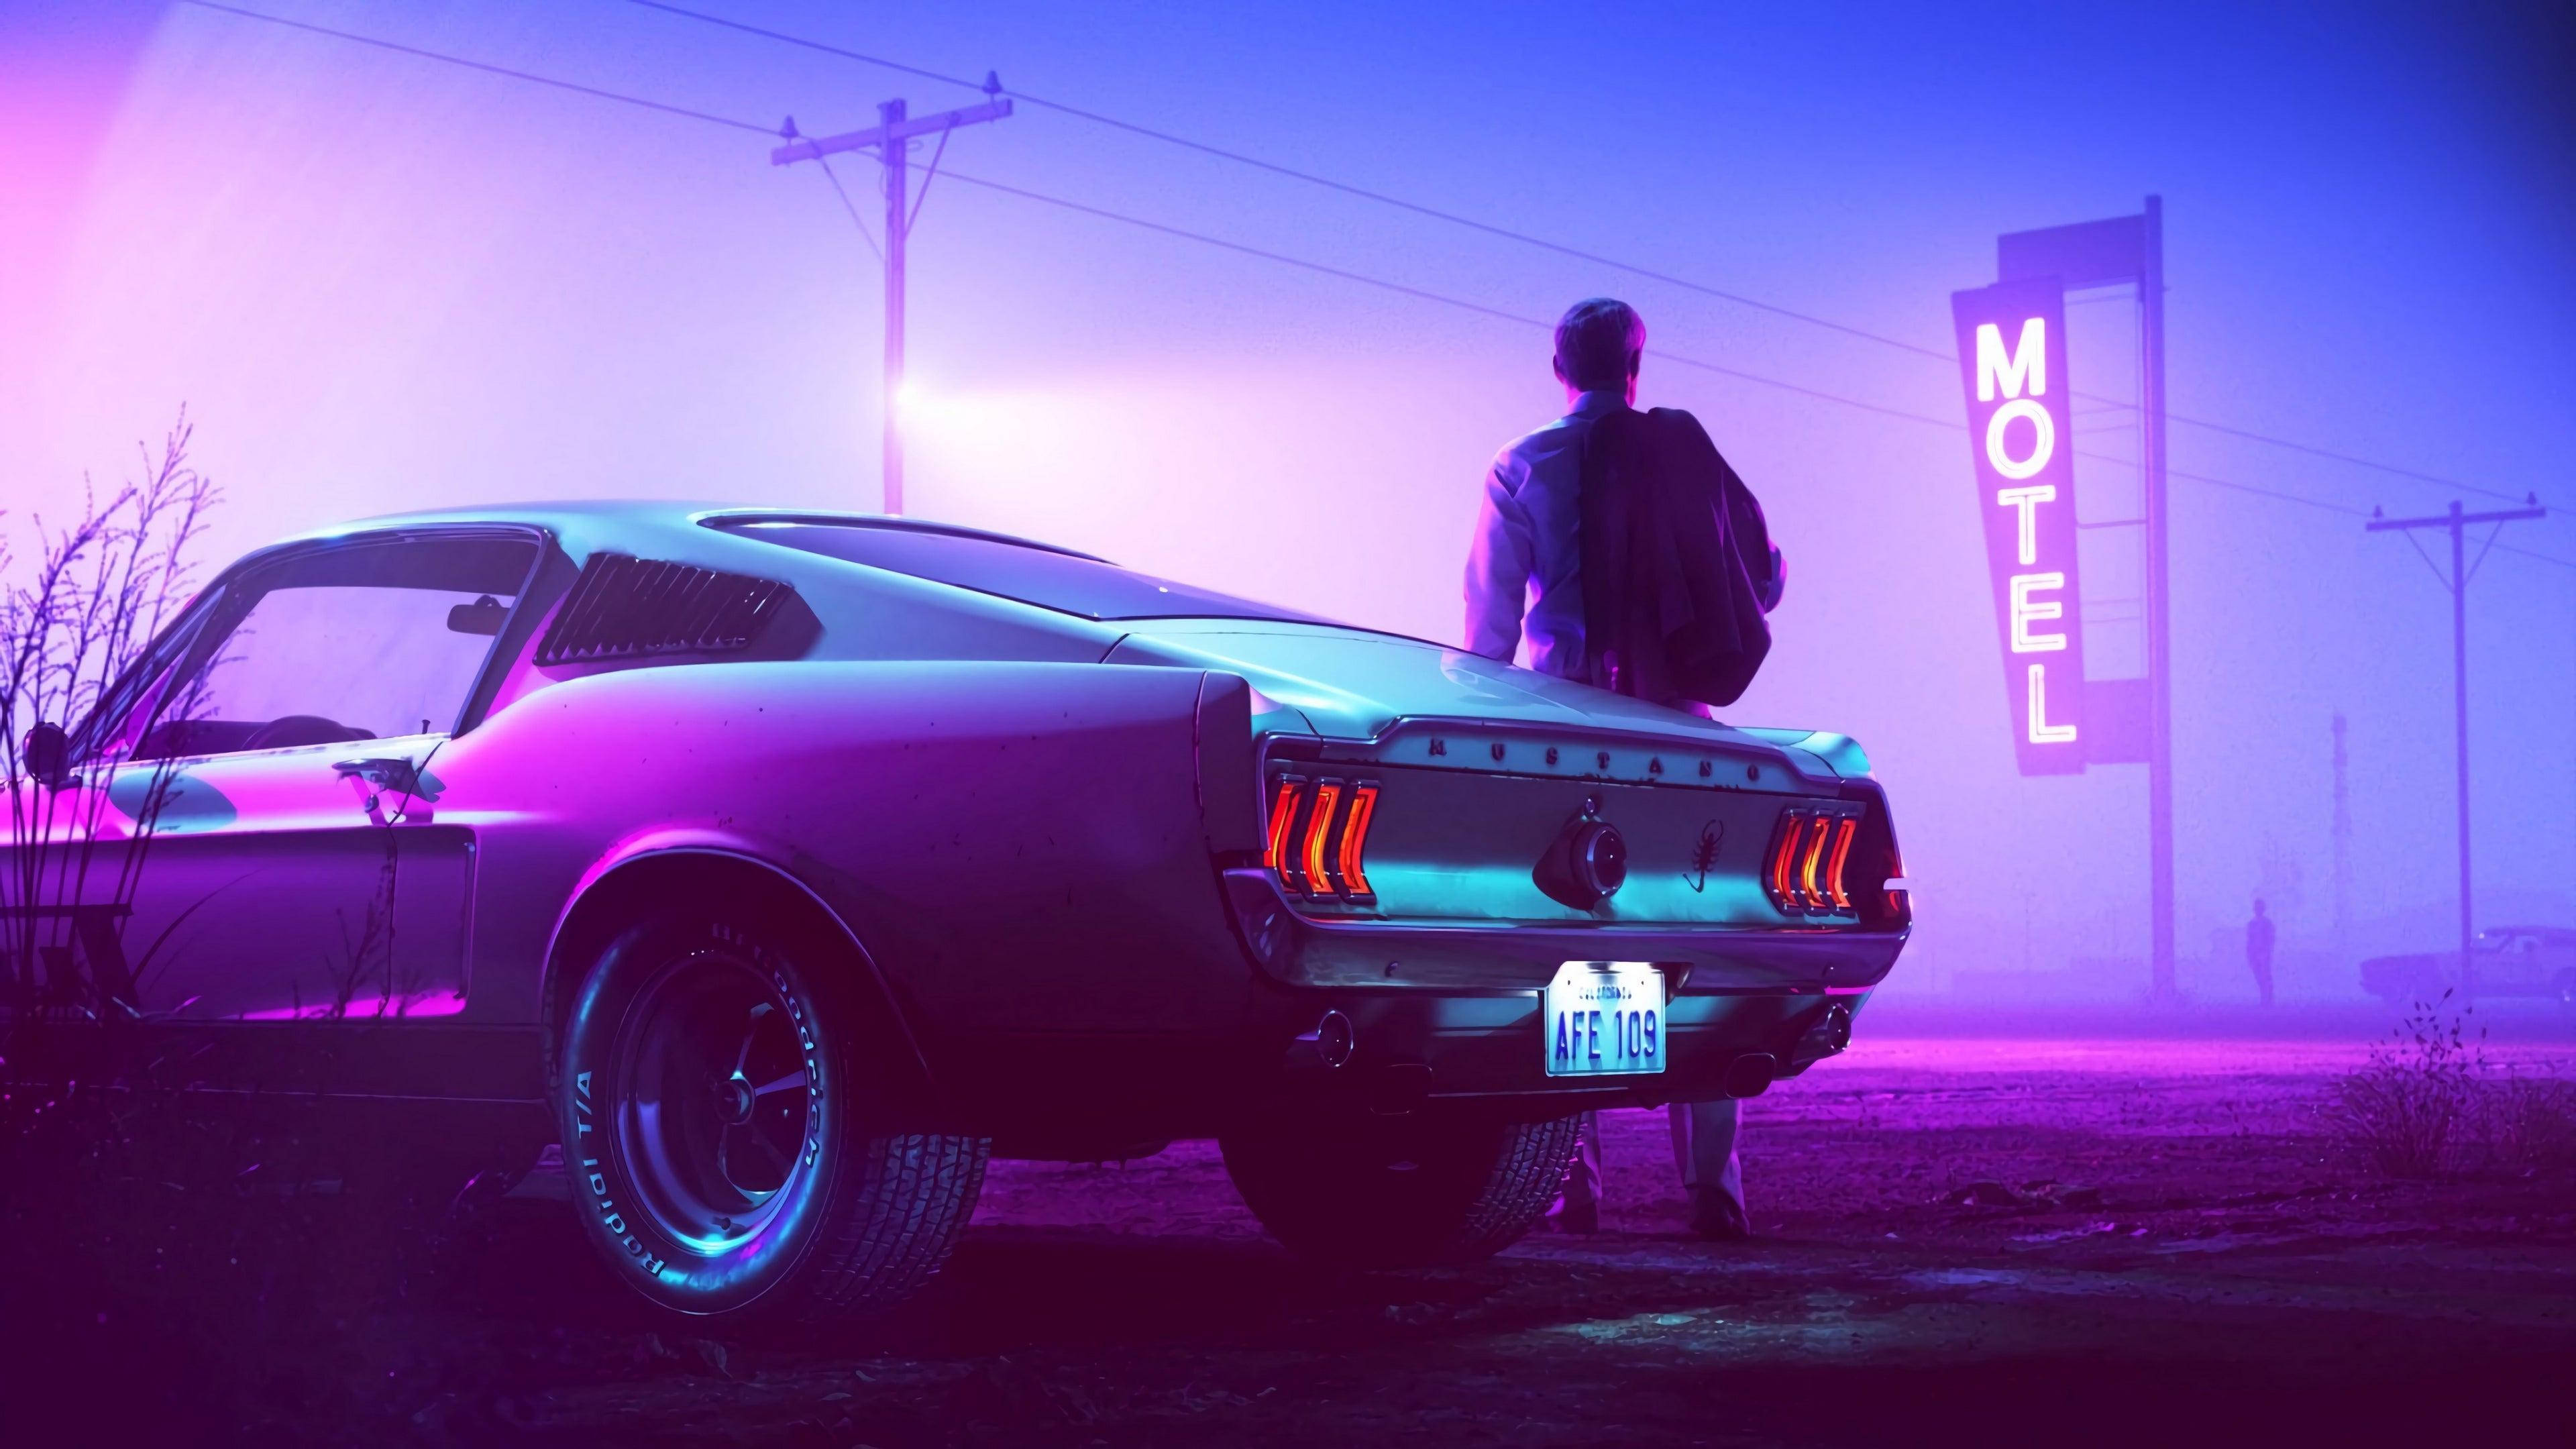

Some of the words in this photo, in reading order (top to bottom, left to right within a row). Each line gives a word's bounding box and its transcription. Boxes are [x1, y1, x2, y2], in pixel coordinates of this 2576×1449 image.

[1976, 317, 2077, 743] MOTEL
[1555, 1010, 1601, 1061] AFE
[1615, 1010, 1656, 1059] 109
[576, 1071, 592, 1140] T/A
[582, 1158, 666, 1277] Radial
